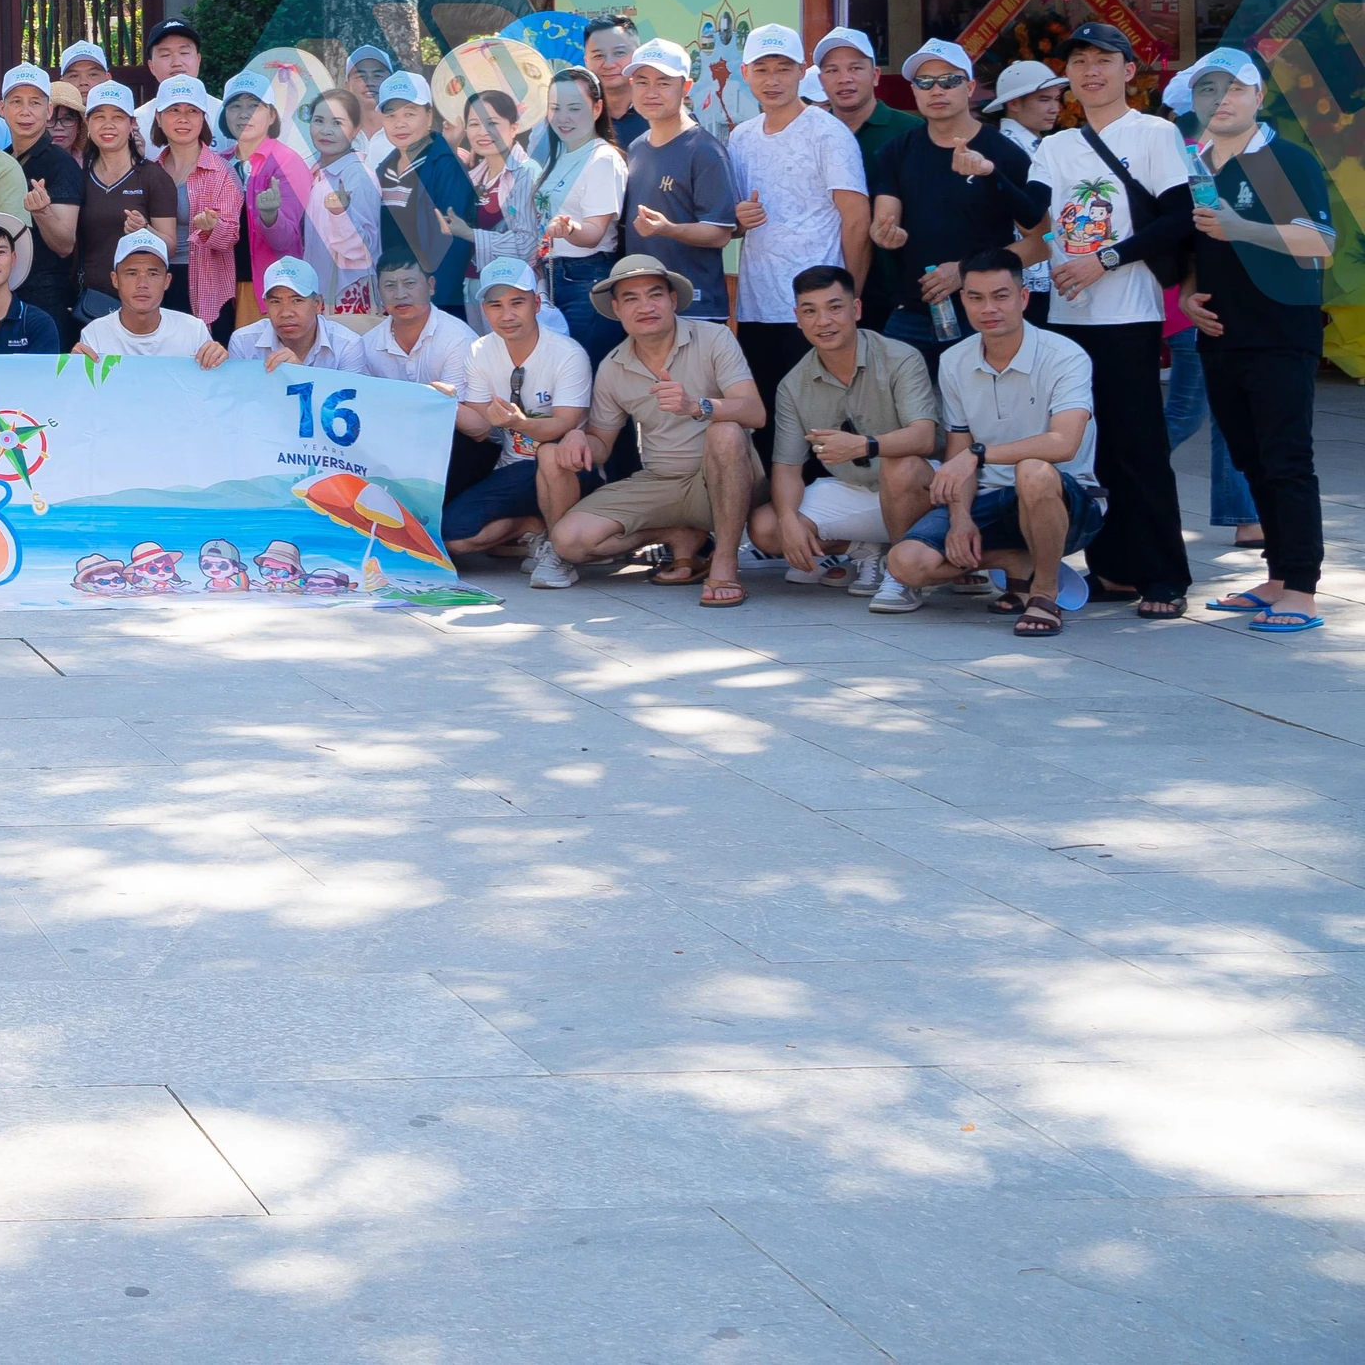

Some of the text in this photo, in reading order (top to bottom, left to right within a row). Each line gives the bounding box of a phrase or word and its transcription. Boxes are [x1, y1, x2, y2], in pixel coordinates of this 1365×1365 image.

[1293, 0, 1312, 17] TY
[536, 391, 551, 403] 16
[285, 381, 361, 447] 16
[302, 443, 345, 456] YEARS
[277, 452, 368, 477] ANNIVERSARY
